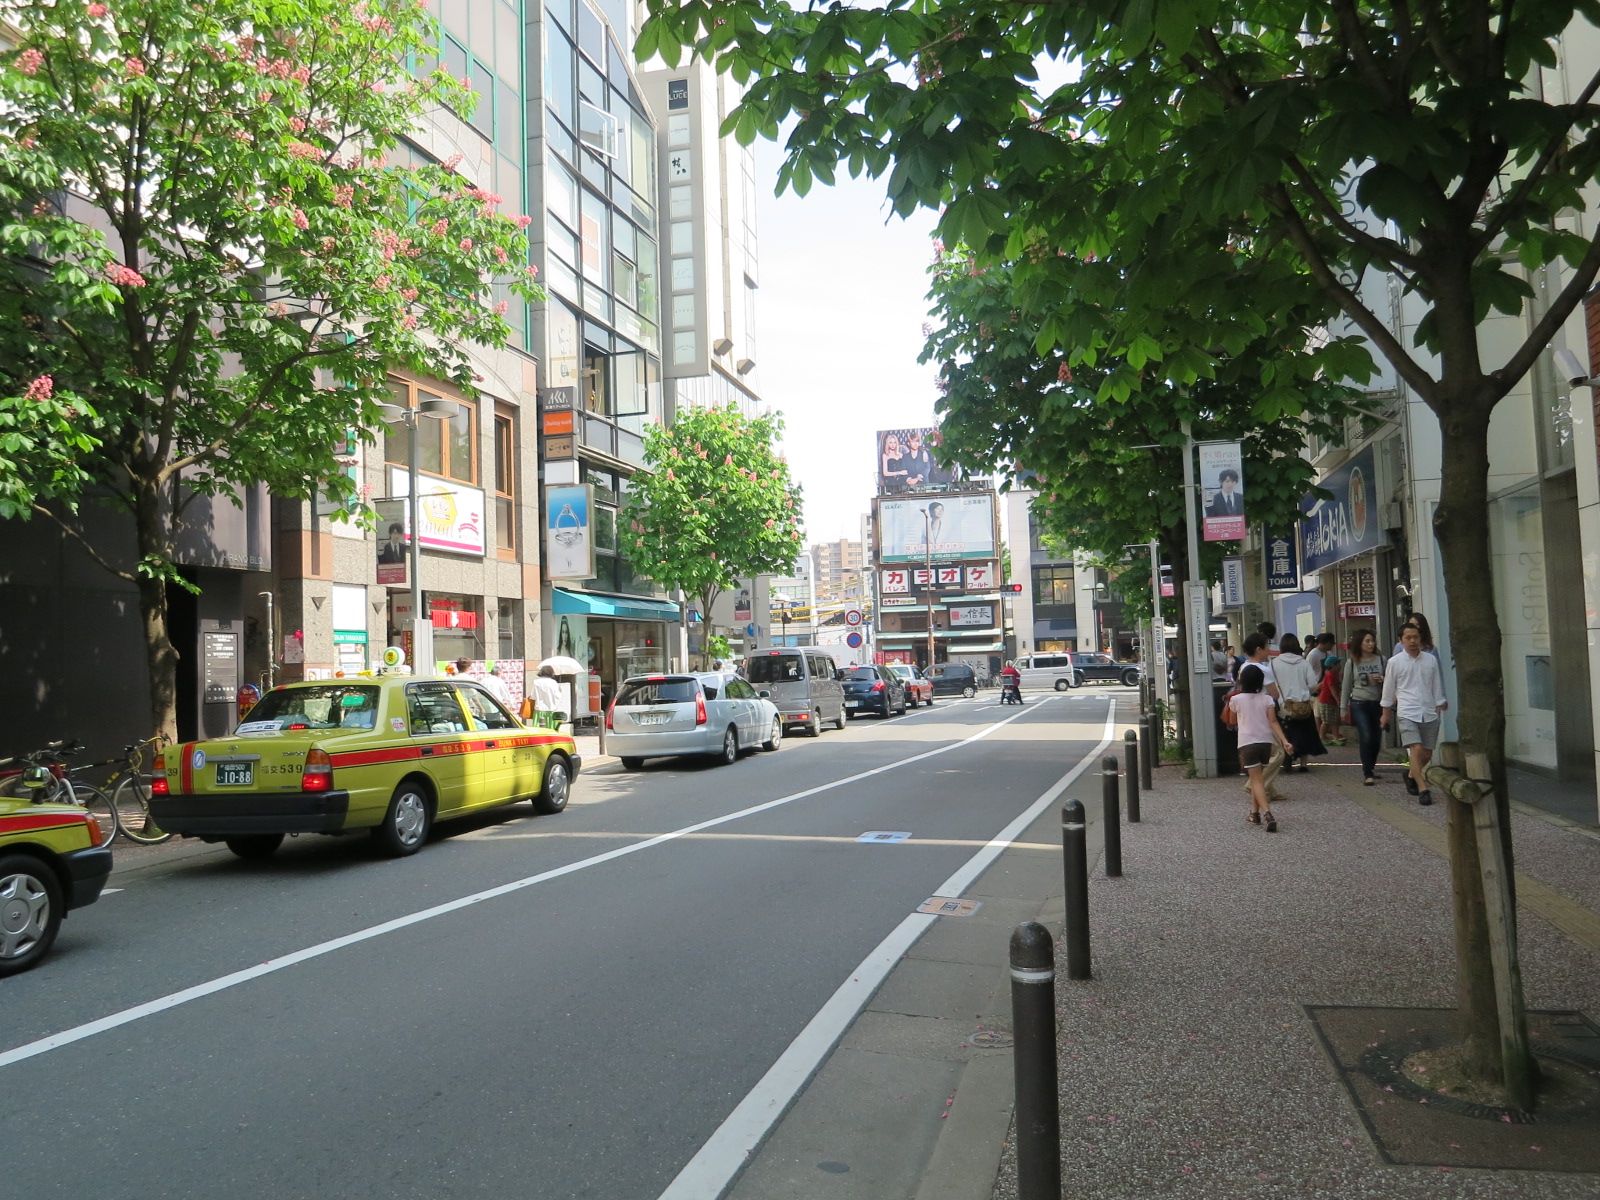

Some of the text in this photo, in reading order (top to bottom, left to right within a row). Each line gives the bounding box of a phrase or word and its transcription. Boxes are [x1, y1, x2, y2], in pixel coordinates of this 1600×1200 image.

[1271, 540, 1291, 575] 倉庫
[1269, 578, 1296, 586] TOKIA
[967, 607, 990, 619] 信長
[1349, 606, 1369, 615] SALE
[849, 614, 859, 623] 30
[167, 768, 179, 777] 39
[224, 771, 252, 783] 10-88
